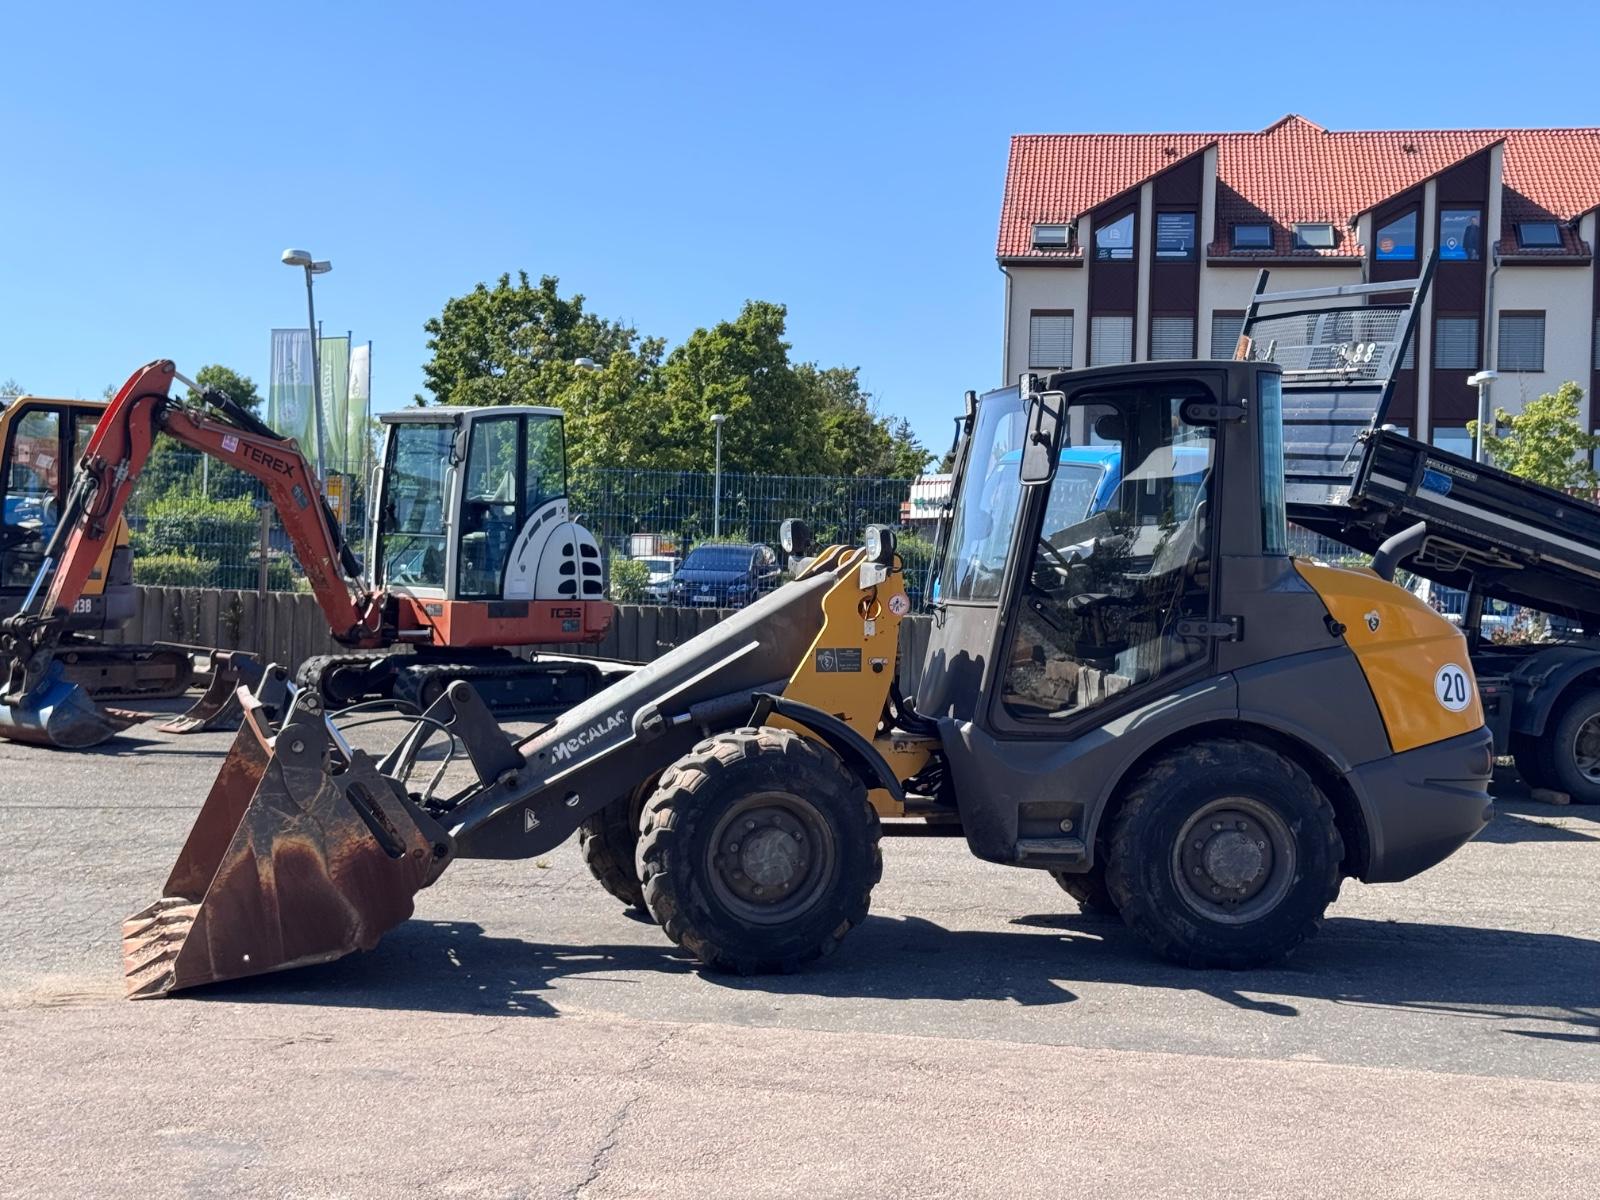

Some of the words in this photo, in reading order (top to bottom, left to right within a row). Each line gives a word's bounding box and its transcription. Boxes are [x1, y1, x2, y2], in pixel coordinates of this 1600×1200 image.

[242, 442, 295, 479] TEREX
[550, 607, 582, 618] TC35
[1441, 672, 1466, 702] 20
